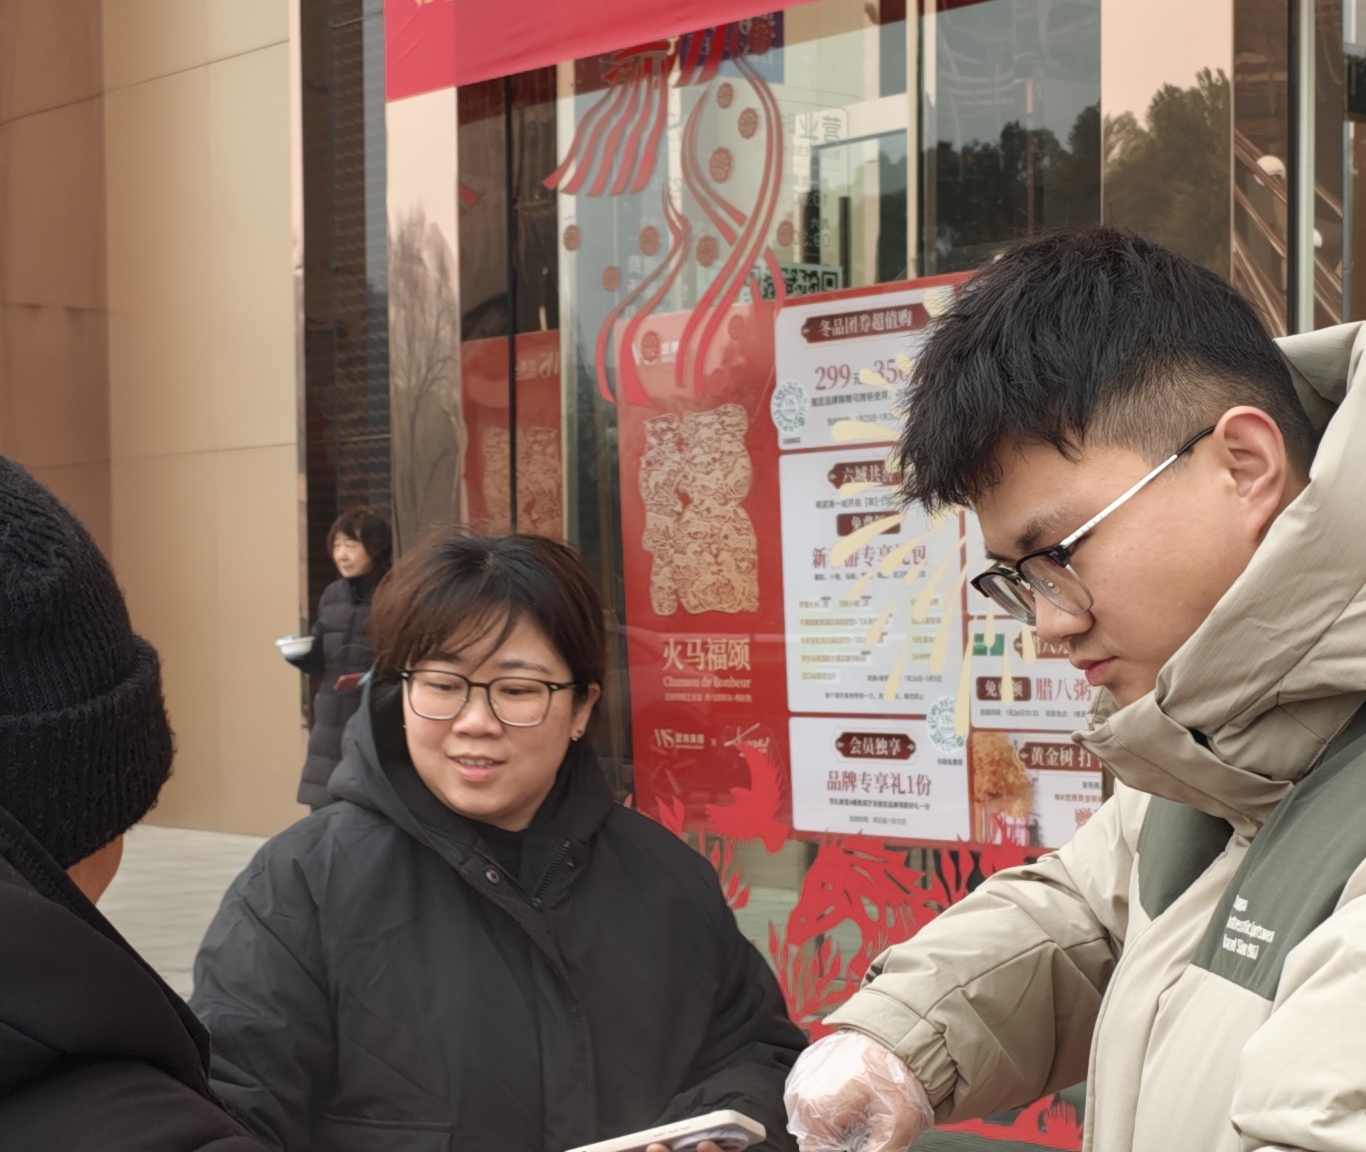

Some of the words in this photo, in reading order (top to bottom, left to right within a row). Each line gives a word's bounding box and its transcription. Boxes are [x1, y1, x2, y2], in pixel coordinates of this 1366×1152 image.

[819, 308, 912, 337] 冬品团券超值购
[662, 638, 751, 671] 火马福颂
[663, 676, 699, 687] Chanson
[701, 676, 712, 687] de
[713, 676, 751, 688] Bonheur
[985, 680, 1023, 697] 免领
[1036, 678, 1093, 701] 腊八粥
[849, 736, 901, 756] 会员独享
[1031, 746, 1073, 768] 黄金树
[1078, 748, 1102, 769] 打
[827, 770, 932, 797] 品牌专享礼1份
